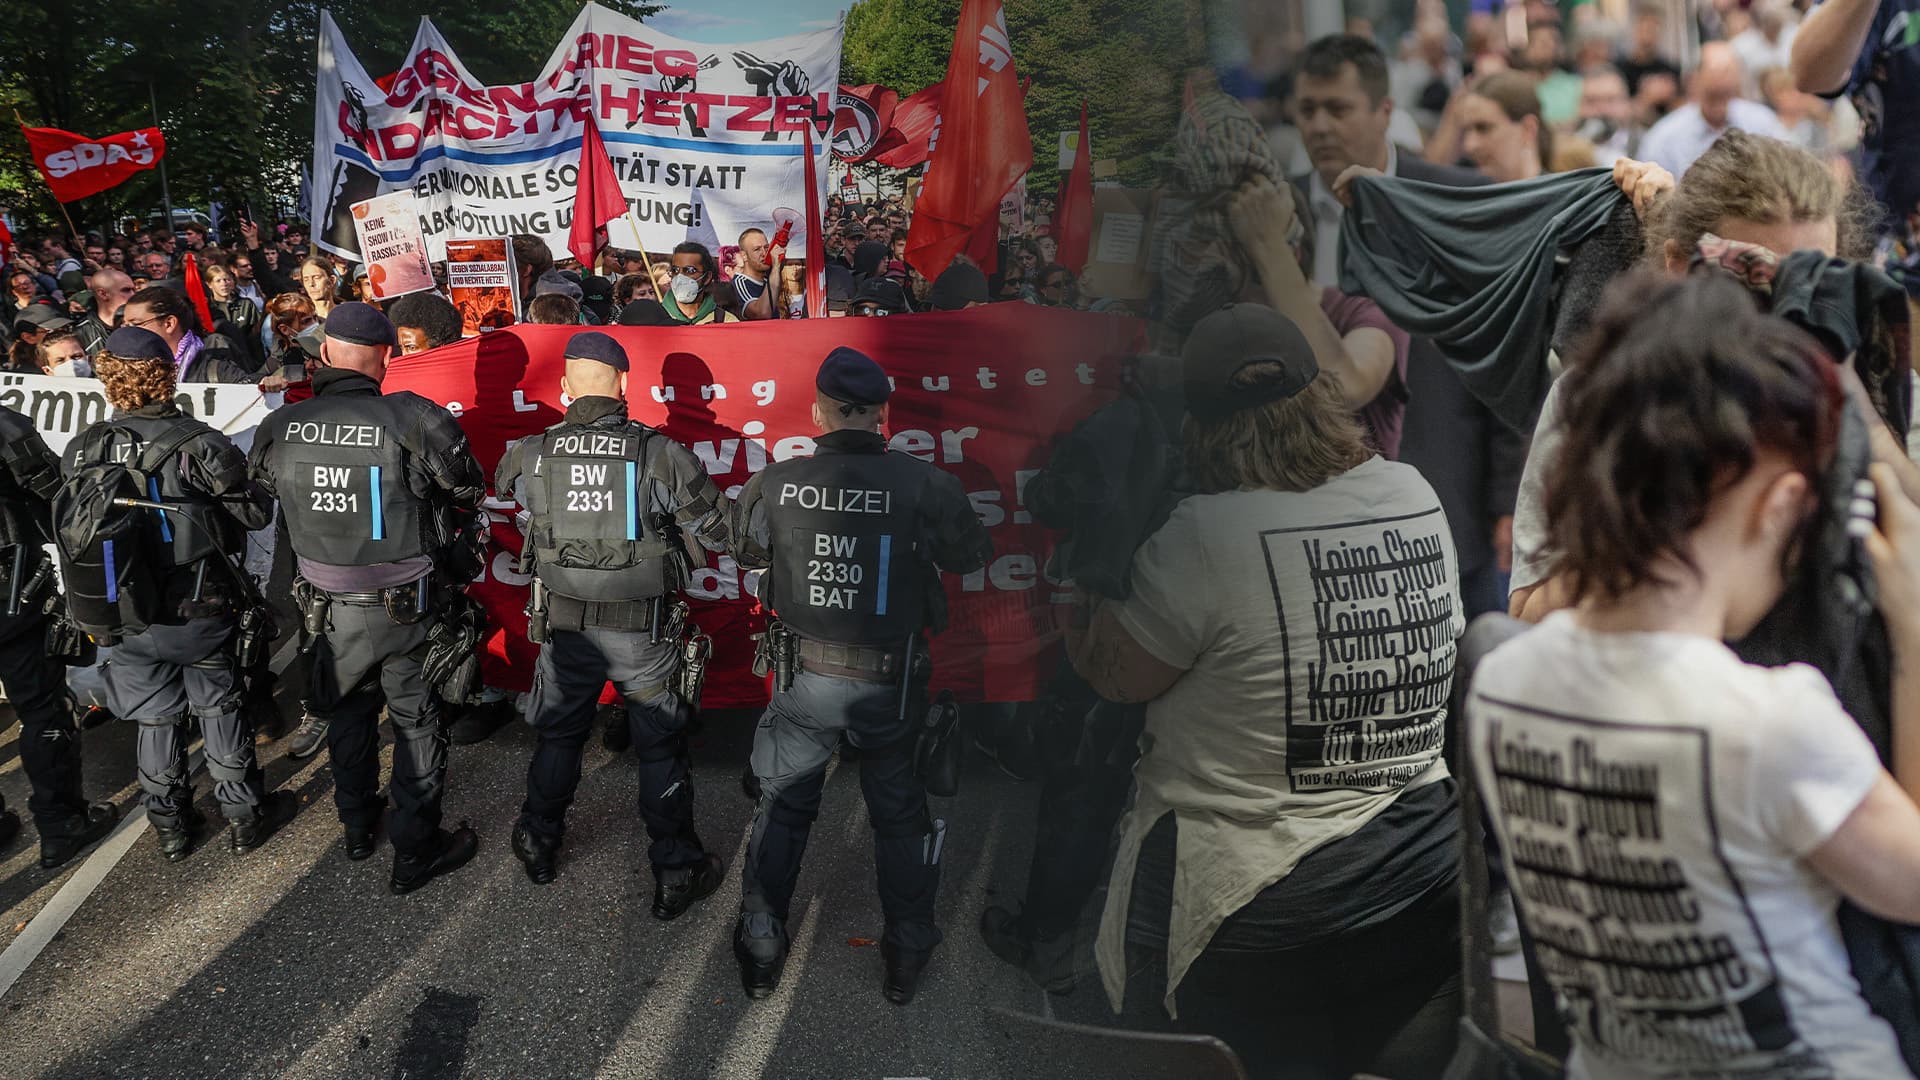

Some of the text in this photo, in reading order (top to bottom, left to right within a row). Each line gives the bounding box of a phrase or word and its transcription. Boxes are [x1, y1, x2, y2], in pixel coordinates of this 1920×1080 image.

[600, 84, 829, 132] HETZE!
[44, 143, 154, 178] SDAJ
[665, 162, 746, 190] STATT
[364, 217, 385, 232] KEINE
[367, 232, 389, 247] SHOW
[285, 421, 380, 447] POLIZEI
[552, 434, 627, 456] POLIZEI
[682, 420, 979, 475] wieer
[314, 466, 351, 489] BW
[570, 464, 607, 486] BW
[310, 491, 358, 513] 2331
[566, 489, 613, 512] 2331
[779, 483, 891, 514] POLIZEI
[814, 533, 857, 559] BW
[807, 560, 863, 584] 2330
[1302, 528, 1447, 604] Keine Show
[809, 584, 858, 610] BAT
[1312, 600, 1397, 665] Keine
[1307, 661, 1390, 723] Keine
